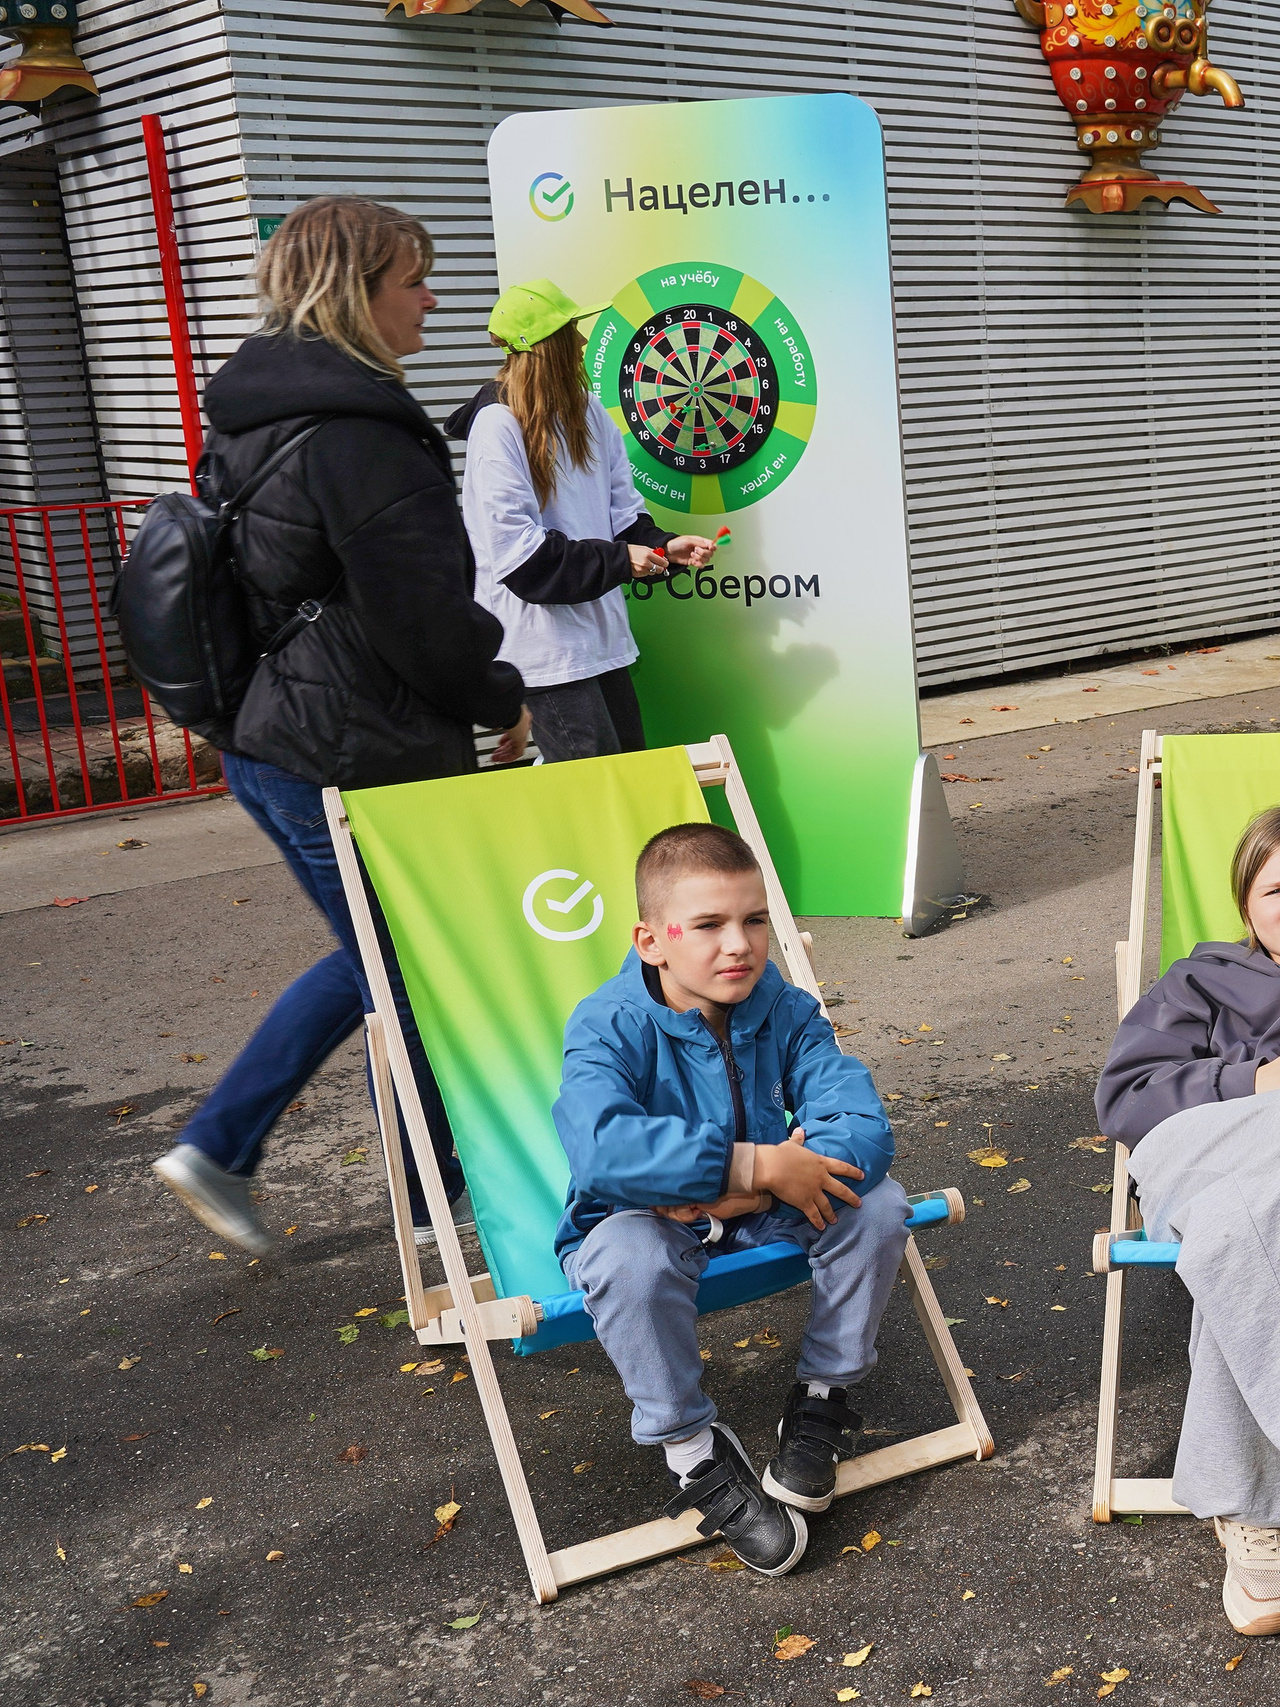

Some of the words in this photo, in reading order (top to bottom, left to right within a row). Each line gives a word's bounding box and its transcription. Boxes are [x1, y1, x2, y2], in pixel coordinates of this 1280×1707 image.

[660, 276, 677, 287] на
[680, 270, 719, 287] учёбу
[665, 314, 672, 324] 5
[683, 309, 696, 320] 20
[707, 311, 713, 322] 1
[643, 326, 656, 336] 12
[725, 320, 737, 331] 18
[633, 342, 641, 352] 9
[744, 337, 752, 347] 4
[593, 321, 617, 378] карьеру
[774, 318, 788, 335] на
[783, 337, 806, 387] работу
[755, 357, 767, 368] 13
[623, 364, 635, 374] 14
[762, 379, 769, 389] 6
[623, 388, 633, 398] 11
[759, 404, 771, 415] 10
[630, 411, 638, 422] 8
[751, 423, 763, 434] 15
[638, 430, 650, 440] 16
[657, 445, 664, 456] 7
[738, 442, 746, 453] 2
[673, 456, 685, 466] 19
[699, 459, 706, 469] 3
[719, 453, 731, 464] 17
[772, 453, 787, 469] на
[629, 462, 668, 495] резуль
[740, 466, 774, 495] успех
[670, 490, 686, 501] на
[666, 564, 820, 607] Сбером
